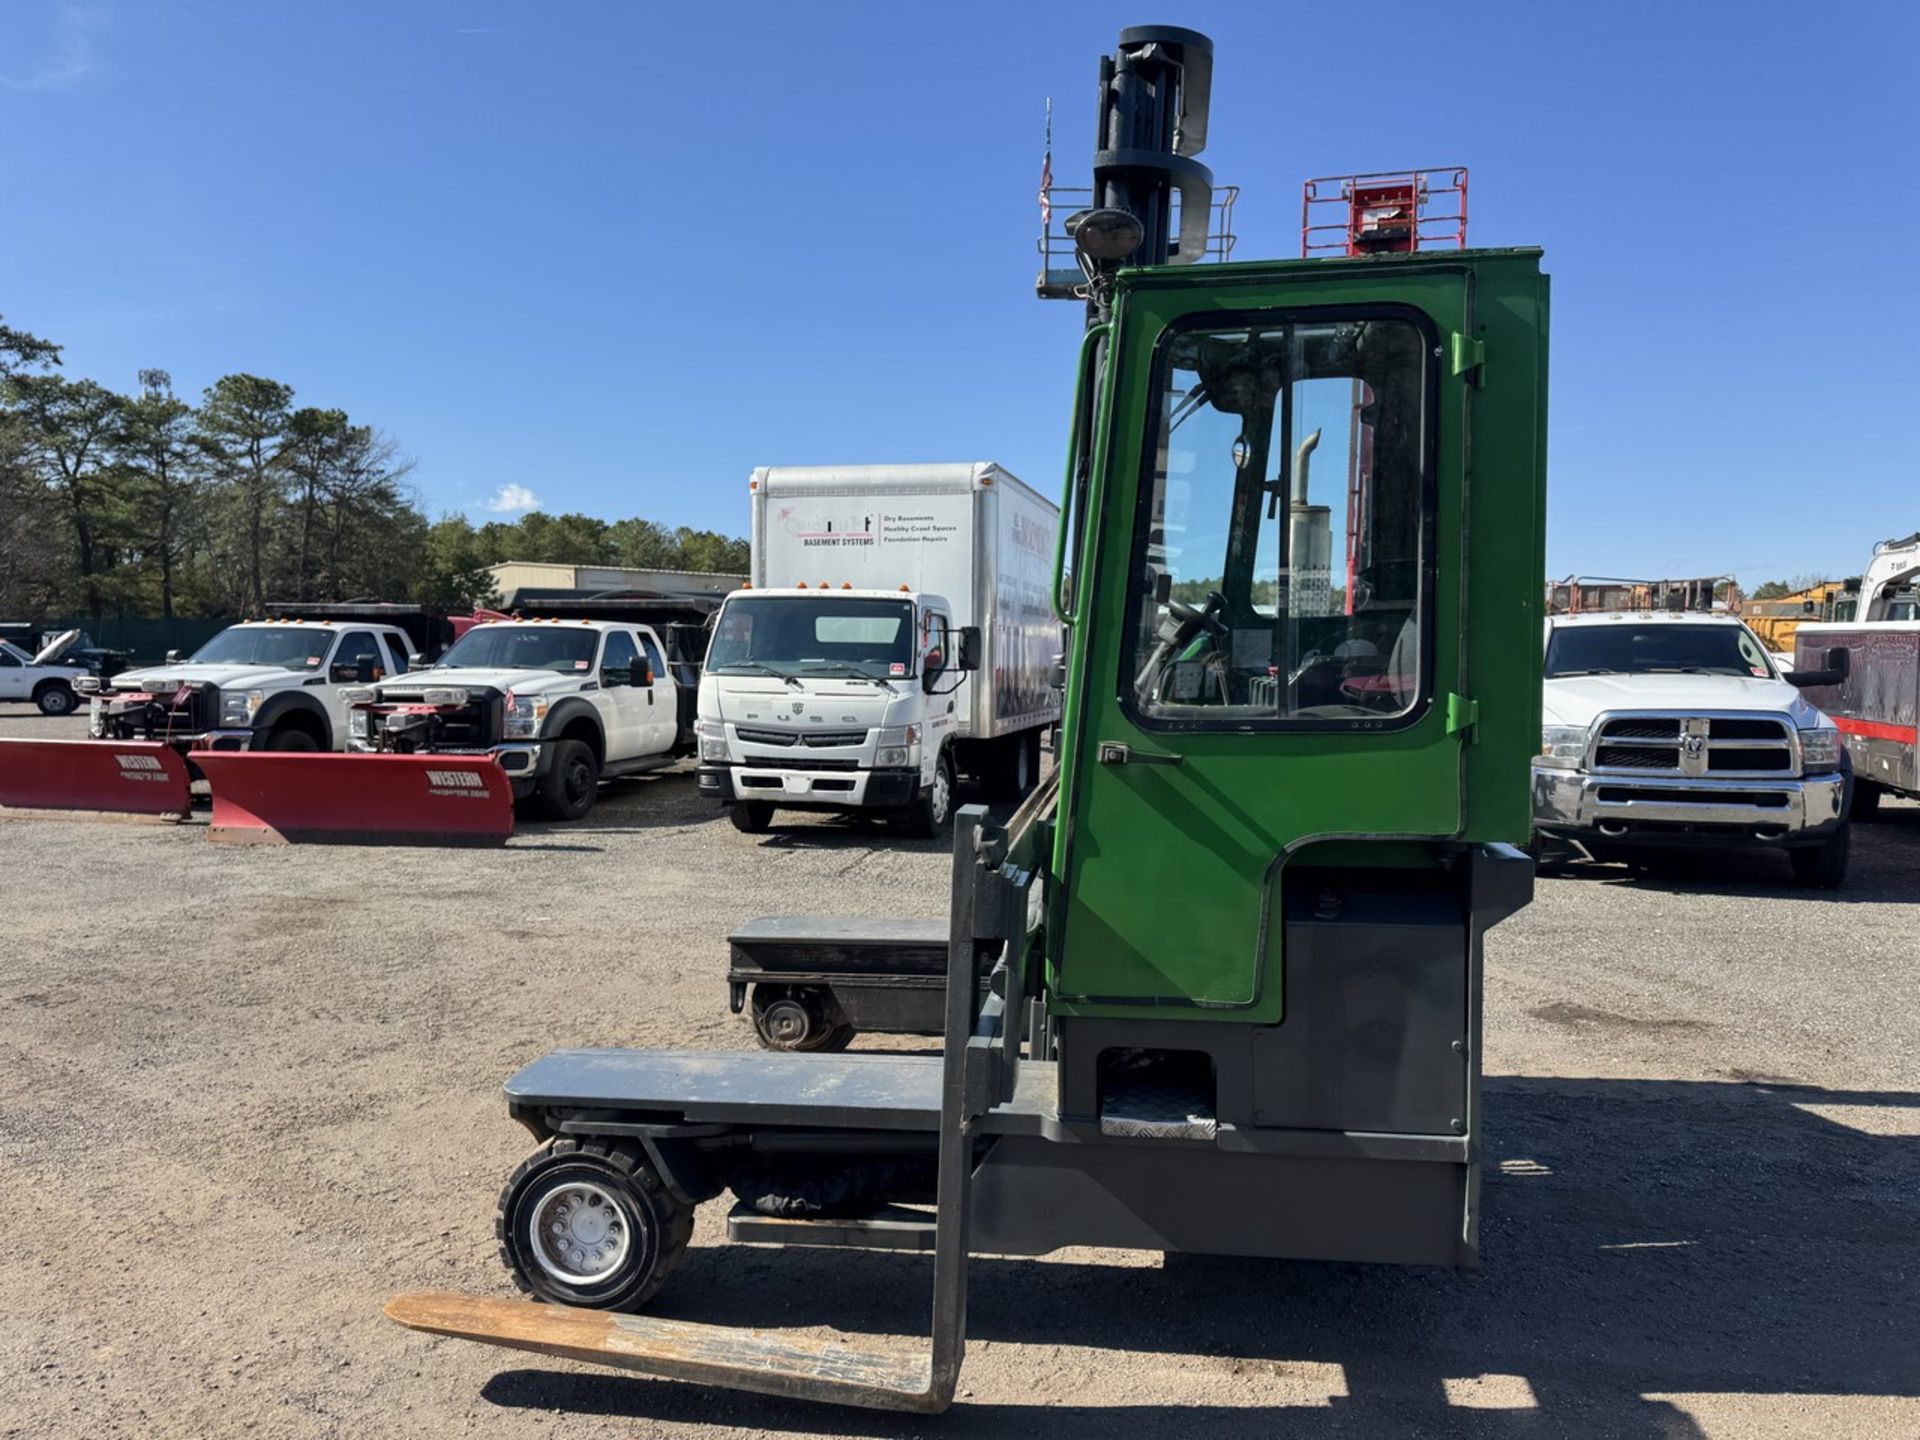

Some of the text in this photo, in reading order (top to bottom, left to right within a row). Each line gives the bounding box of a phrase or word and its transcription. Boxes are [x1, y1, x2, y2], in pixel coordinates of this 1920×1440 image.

[803, 538, 874, 547] BASEMENT SYSTEMS
[425, 770, 483, 787] WESTERN
